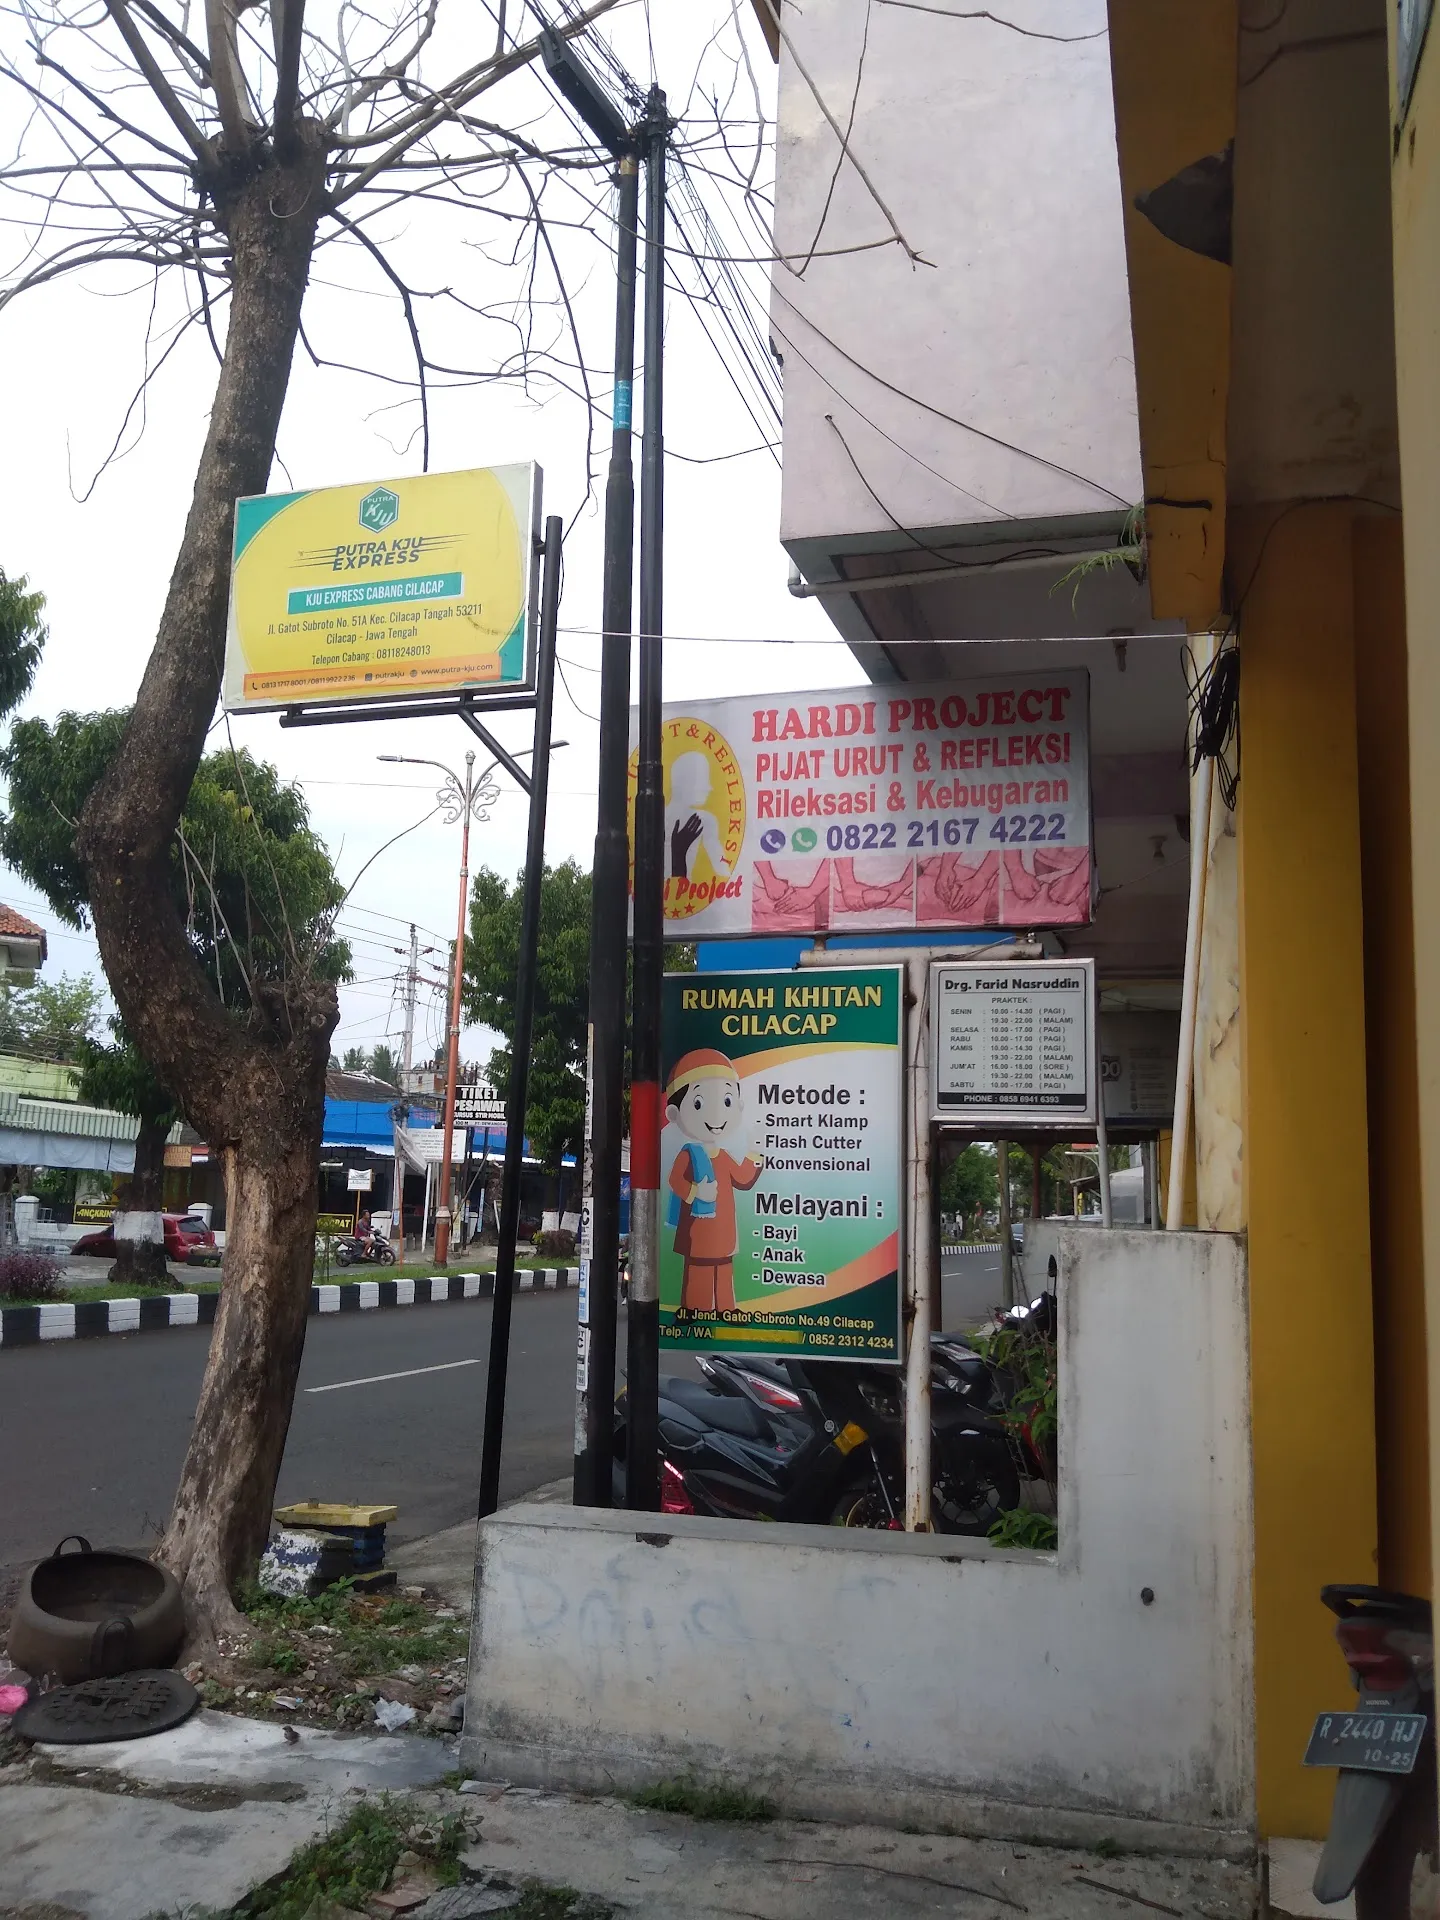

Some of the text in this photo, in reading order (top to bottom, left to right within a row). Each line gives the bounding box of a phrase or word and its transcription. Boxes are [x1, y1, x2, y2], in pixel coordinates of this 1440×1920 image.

[367, 496, 394, 504] PUTRA
[335, 537, 423, 558] PUTRA KJU
[333, 550, 420, 571] EXPRESS
[306, 580, 445, 607] KJU EXPRESS CABANG CILACAP
[278, 622, 300, 634] Gatot
[302, 620, 334, 632] Subroto
[337, 617, 349, 629] No.
[352, 615, 368, 627] 51A
[370, 614, 387, 625] Kec.
[390, 612, 421, 623] Cilacap
[424, 607, 454, 621] Tangah
[456, 604, 482, 617] 53211
[326, 633, 357, 645] Cilacap
[366, 630, 386, 641] Jawa
[388, 626, 418, 640] Tengah
[312, 655, 340, 666] Telepon
[342, 652, 370, 663] Cabang
[376, 645, 431, 660] 08118248013
[375, 670, 405, 680] putrakju
[421, 663, 493, 675] www.putra-kju.com
[752, 687, 1072, 743] HARDI PROJECT
[756, 733, 1071, 782] PIJAT URUT & REFLEKSI
[757, 777, 1069, 819] Rileksasi & Kebugaran
[826, 813, 1067, 852] 0822 2167 4222
[676, 875, 743, 904] Project
[945, 978, 1080, 992] Drg. Farid Nasruddin
[682, 986, 882, 1010] RUMAH KHITAN
[721, 1013, 838, 1037] CILACAP
[461, 1088, 499, 1100] TIKET
[758, 1084, 851, 1106] Metode
[964, 1095, 993, 1103] PHONE
[454, 1100, 507, 1112] PESAWAT
[765, 1113, 813, 1129] Smart
[818, 1114, 869, 1131] Klamp
[765, 1135, 808, 1149] Flash
[812, 1135, 863, 1150] Cutter
[765, 1156, 871, 1172] Konvensional
[756, 1193, 868, 1221] Melayani
[764, 1226, 798, 1243] Bayi
[763, 1247, 805, 1263] Anak
[763, 1270, 826, 1286] Dewasa
[677, 1310, 875, 1332] Jl. Jend. Gatot Subroto No.49 Cilacap
[659, 1325, 685, 1339] Telp.
[809, 1334, 835, 1346] 0852
[838, 1335, 865, 1347] 2312
[867, 1336, 895, 1349] 4234
[1320, 1717, 1419, 1743] R 2440 HJ
